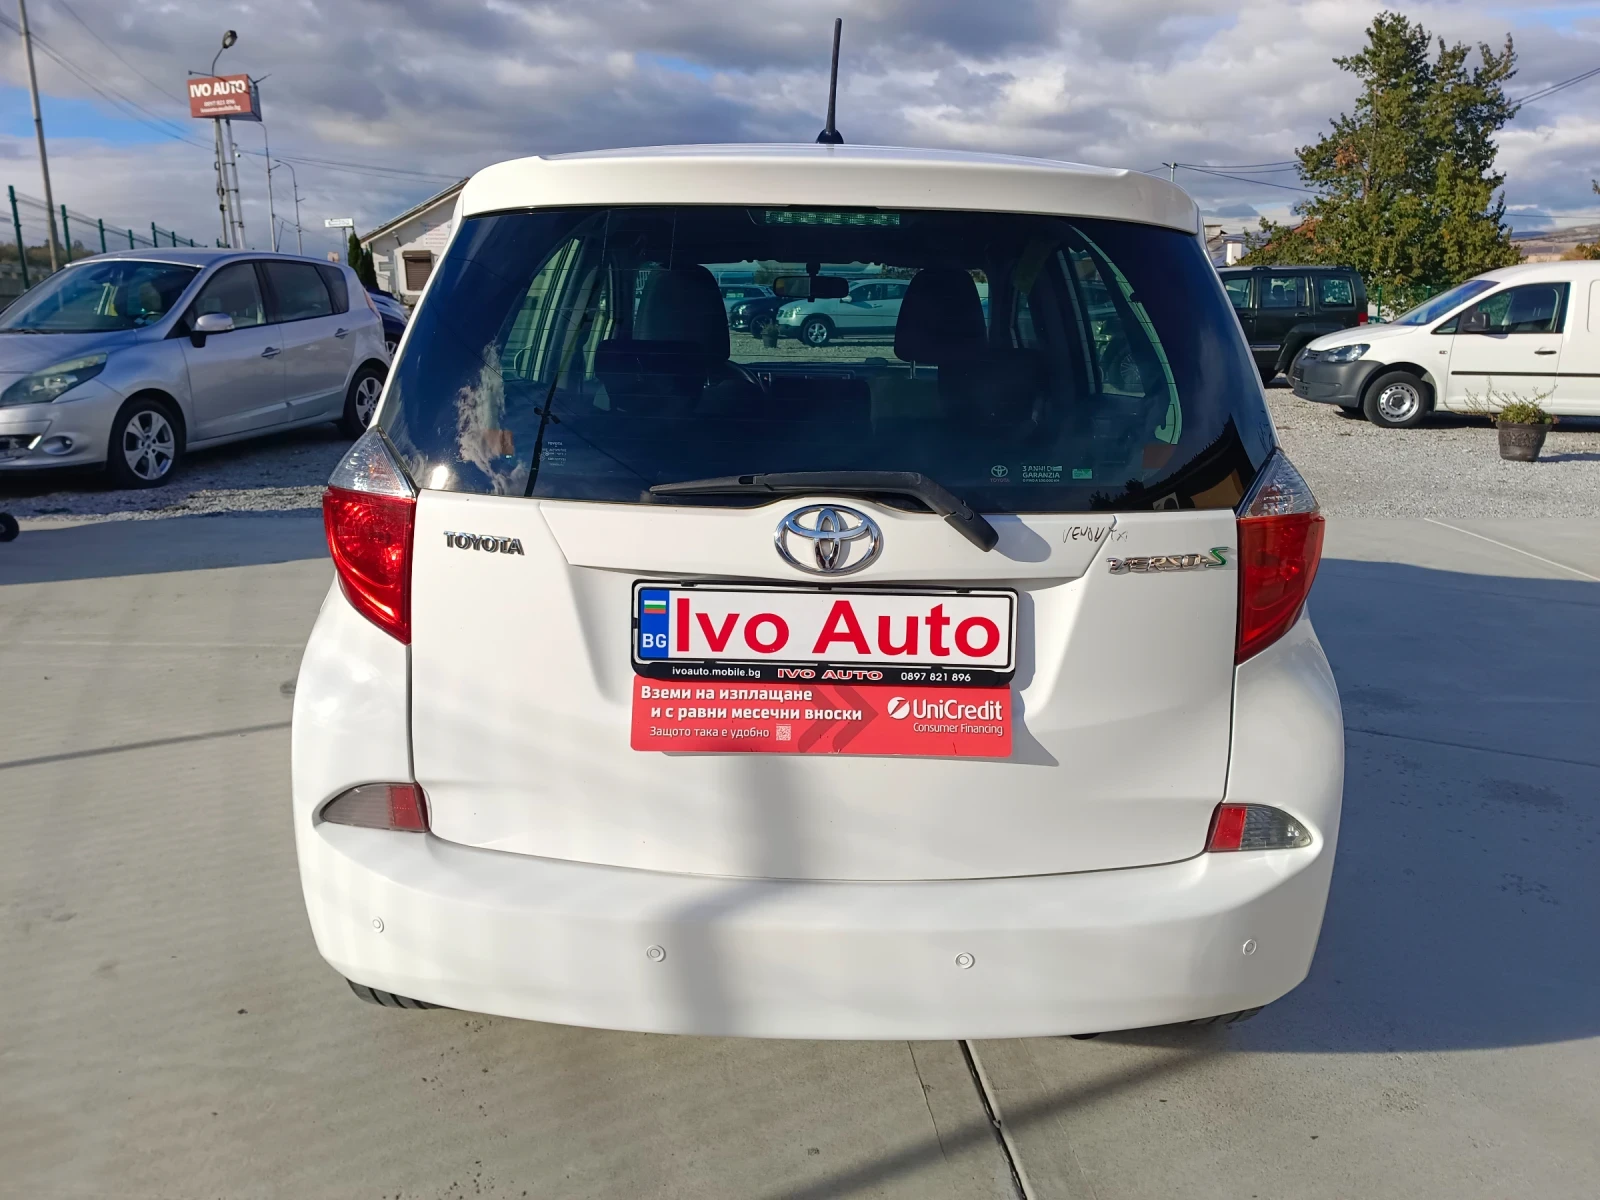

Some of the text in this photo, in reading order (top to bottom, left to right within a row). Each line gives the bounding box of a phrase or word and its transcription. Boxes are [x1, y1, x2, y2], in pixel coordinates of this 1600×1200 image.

[189, 79, 246, 98] IVO AUTO
[443, 531, 525, 556] TOYOTA
[676, 598, 1000, 657] Ivo Auto
[642, 633, 667, 648] BG
[672, 666, 761, 678] ivoauto.mobile.bg
[777, 668, 883, 680] IVO AUTO
[900, 672, 971, 682] 0897 821 896
[641, 685, 813, 702] Вземи на изплащане
[651, 707, 862, 721] и с равни месечни вноски
[912, 699, 1003, 720] UniCredit
[650, 726, 770, 739] Защото така е удобно
[913, 722, 1003, 736] Consumer Financing
